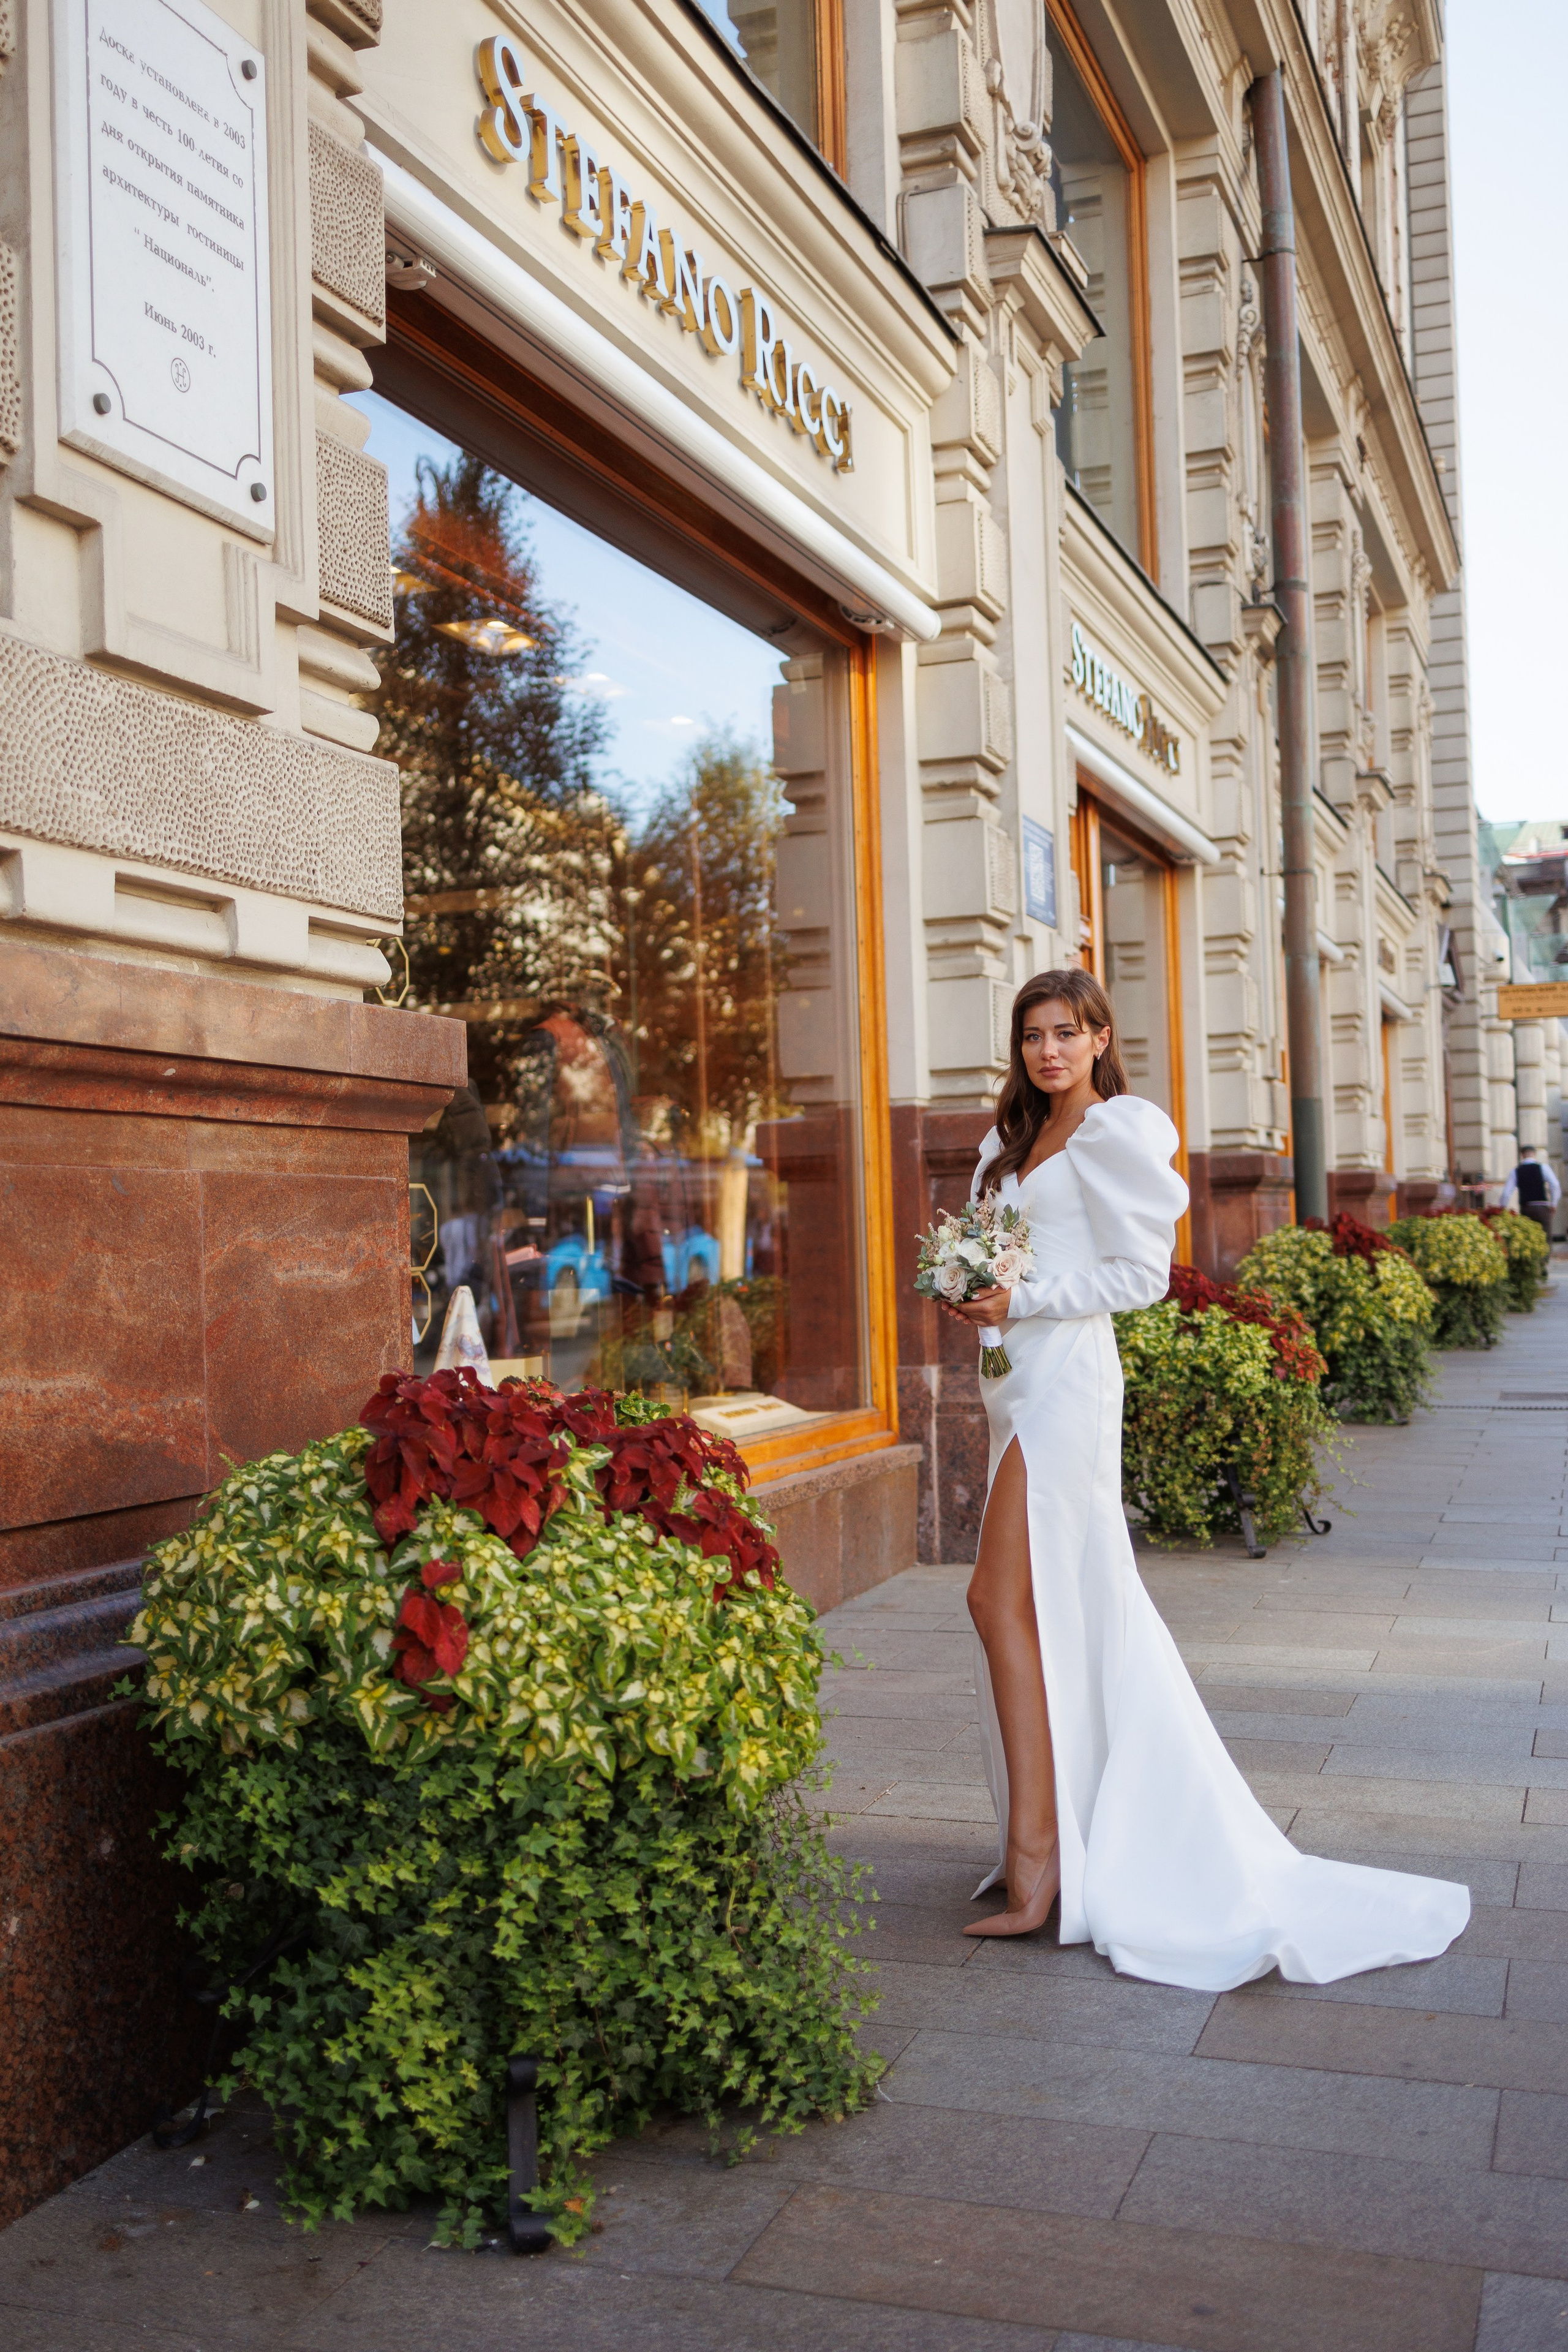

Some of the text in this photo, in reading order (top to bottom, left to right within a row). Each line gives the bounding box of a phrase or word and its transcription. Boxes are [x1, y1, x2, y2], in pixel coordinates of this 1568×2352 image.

[100, 26, 246, 149] Доска установлена в 2003
[100, 74, 127, 104] году
[131, 96, 138, 110] в
[142, 105, 173, 136] честь
[232, 173, 244, 189] со
[101, 120, 245, 231] дня открытия памятника
[102, 165, 244, 271] архитектуры гостиницы
[478, 34, 856, 473] STEFANO RICCI
[144, 301, 216, 358] Июнь 2003 г.
[1071, 621, 1145, 741] STEFANO
